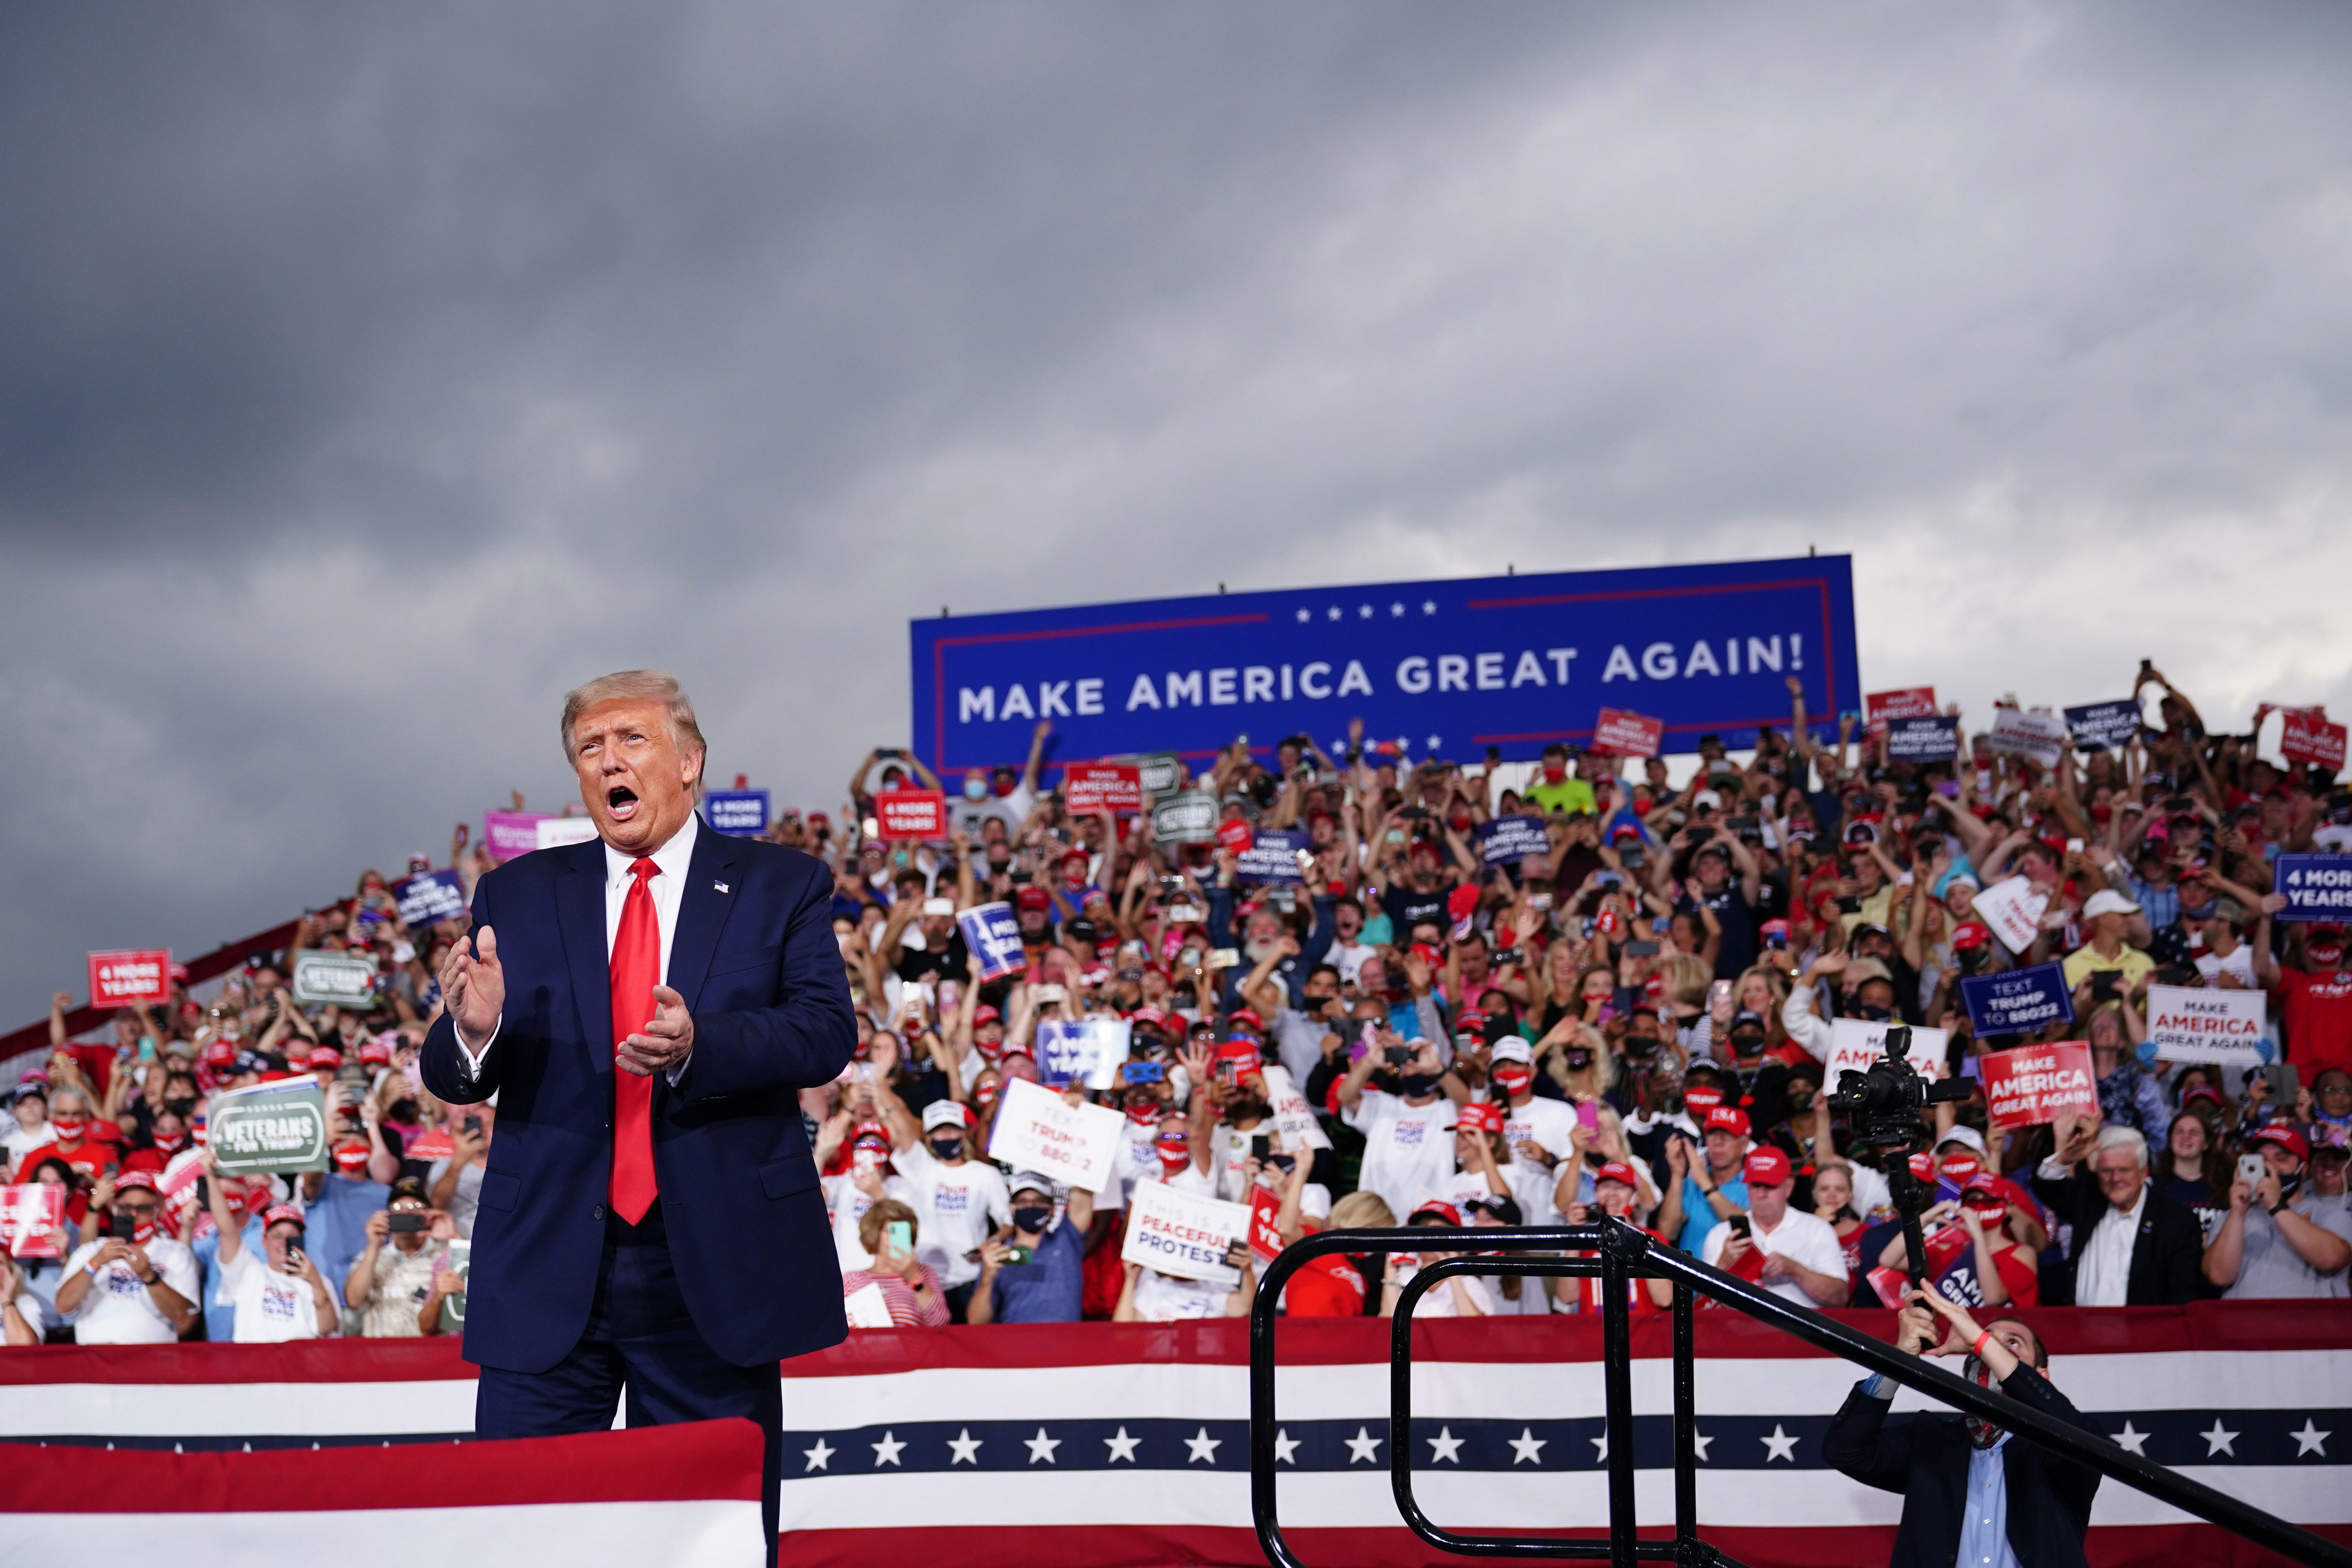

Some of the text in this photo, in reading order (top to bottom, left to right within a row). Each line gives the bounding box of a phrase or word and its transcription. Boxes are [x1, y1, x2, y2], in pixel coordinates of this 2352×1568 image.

[960, 635, 1801, 723] MAKE AMERICA GREAT AGAIN!
[2072, 712, 2142, 734] AMERICA
[1890, 728, 1956, 743] AMERICA
[1069, 780, 1139, 793] AMERICA
[883, 802, 937, 815] 4 MORE
[885, 816, 937, 830] YEARS!
[1484, 830, 1546, 851] AMERICA
[1238, 849, 1296, 864] AMERIC
[2286, 870, 2302, 887] 4
[98, 963, 160, 980] 4 MORE
[100, 979, 160, 996] YEARS!
[1991, 978, 2032, 996] TEXT
[1987, 990, 2047, 1011] TRUMP
[2184, 1002, 2228, 1015] MAKE
[1982, 1003, 2059, 1025] TO 88022
[2156, 1014, 2258, 1035] AMERICA
[2155, 1032, 2203, 1048] GREAT
[2011, 1056, 2056, 1074] MAKE
[1990, 1069, 2090, 1098] AMERICA
[1687, 1094, 1721, 1105] TRUMP
[1992, 1089, 2092, 1116] GREAT AGAIN
[1711, 1108, 1736, 1124] USA
[224, 1117, 313, 1143] VETERANS
[857, 1121, 882, 1133] USA
[233, 1137, 304, 1154] FOR TRUMP
[1157, 1147, 1189, 1161] TRUMP
[1940, 1161, 1976, 1174] TRUMP
[1146, 1198, 1232, 1233] THIS IS A
[1142, 1214, 1230, 1250] PEACEFUL
[1139, 1231, 1227, 1265] PROTEST
